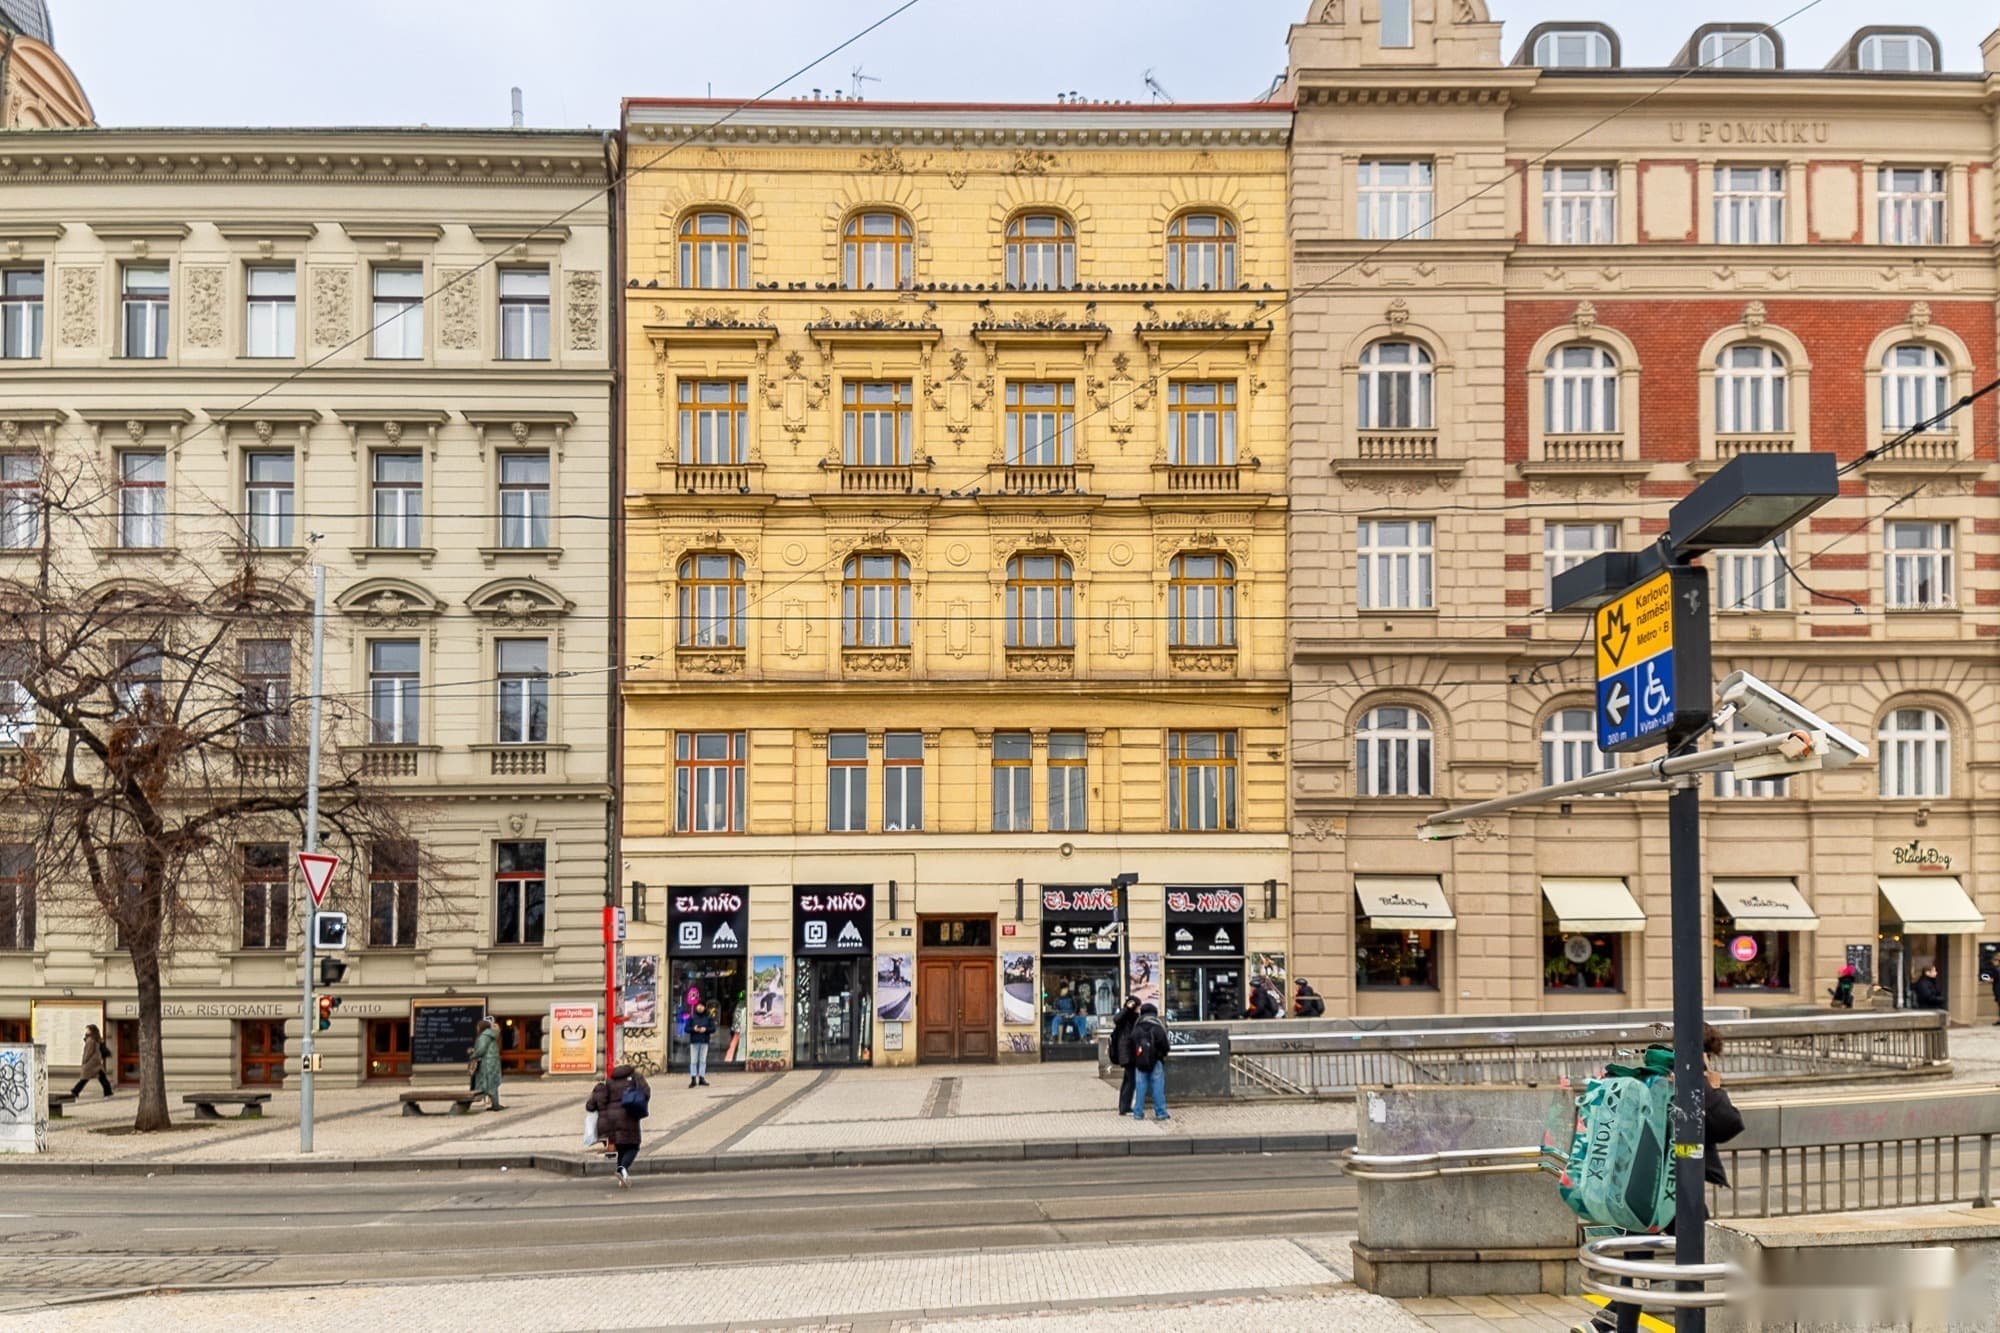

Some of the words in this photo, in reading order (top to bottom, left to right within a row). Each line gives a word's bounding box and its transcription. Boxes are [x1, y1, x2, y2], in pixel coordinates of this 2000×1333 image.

[1668, 121, 1686, 142] U
[1698, 119, 1831, 143] POMNÍKU
[1636, 584, 1669, 609] Karlovo
[1637, 599, 1670, 627] náměstí
[1637, 629, 1657, 645] Metro
[1664, 620, 1670, 632] B
[1640, 718, 1659, 734] Výtah
[676, 895, 699, 912] EL
[801, 895, 824, 911] EL
[1044, 891, 1071, 910] EL
[1168, 892, 1196, 912] EL
[125, 1004, 185, 1016] PIRIA
[197, 1004, 283, 1016] RISTORANTE
[1586, 1119, 1614, 1181] YONEX
